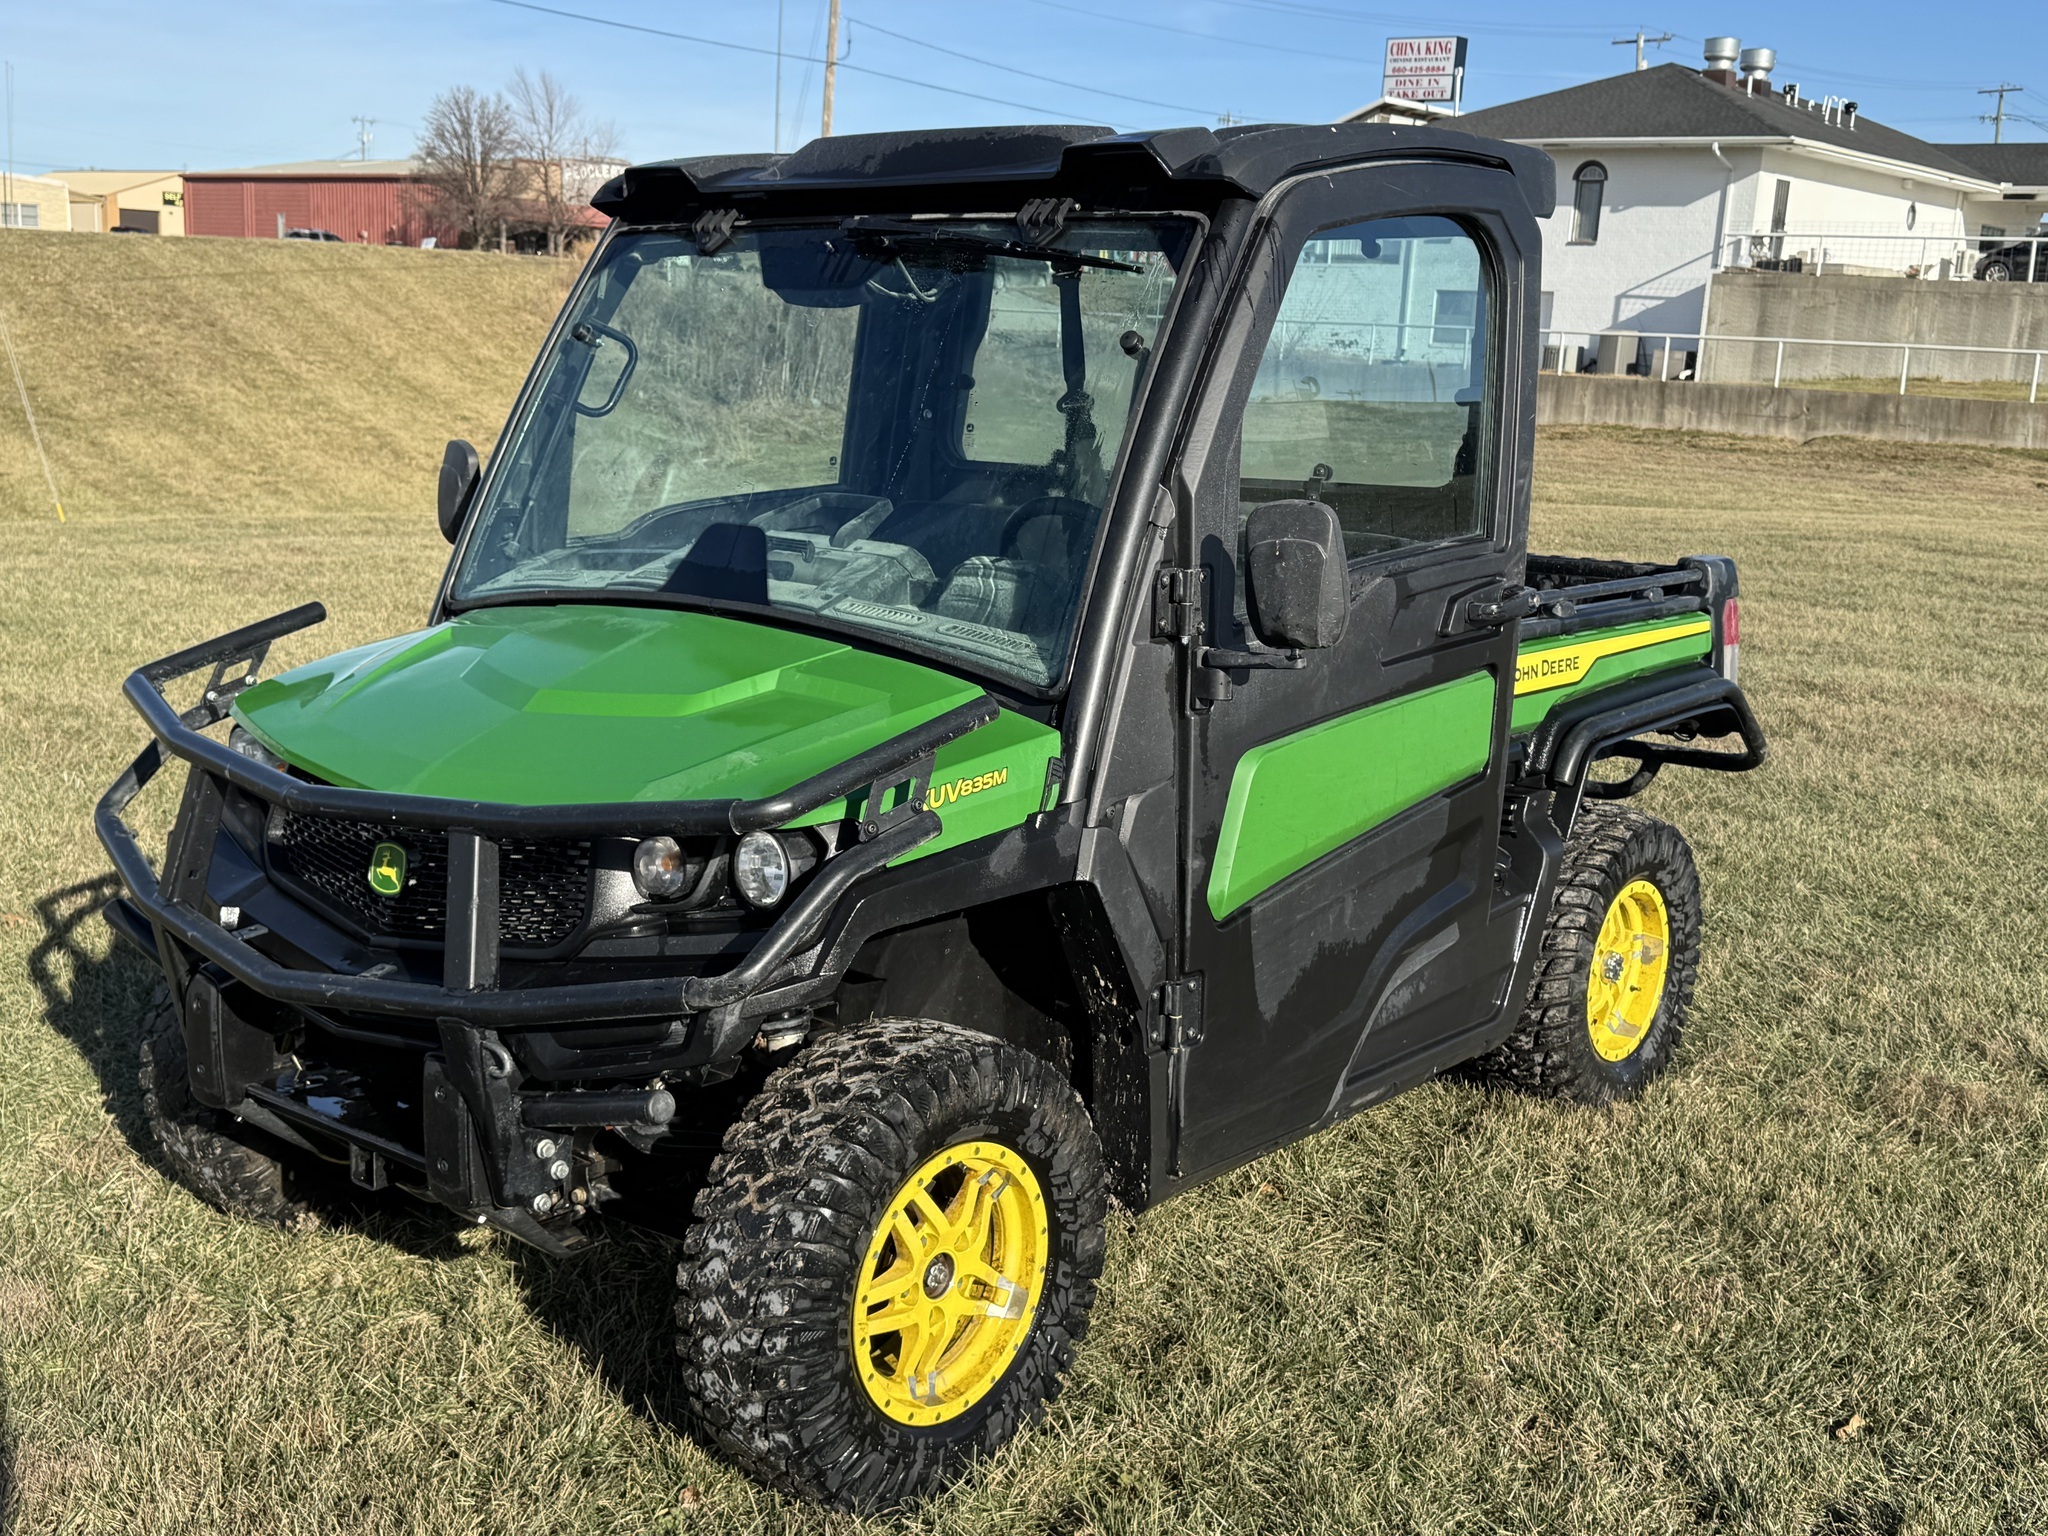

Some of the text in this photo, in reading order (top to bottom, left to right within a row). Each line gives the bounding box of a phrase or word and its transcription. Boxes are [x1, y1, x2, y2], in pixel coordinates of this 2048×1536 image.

[1390, 41, 1452, 56] CHINA KING
[1395, 79, 1423, 87] DINE
[1388, 89, 1446, 98] TAKE OUT
[1514, 656, 1580, 682] OHN DEERE
